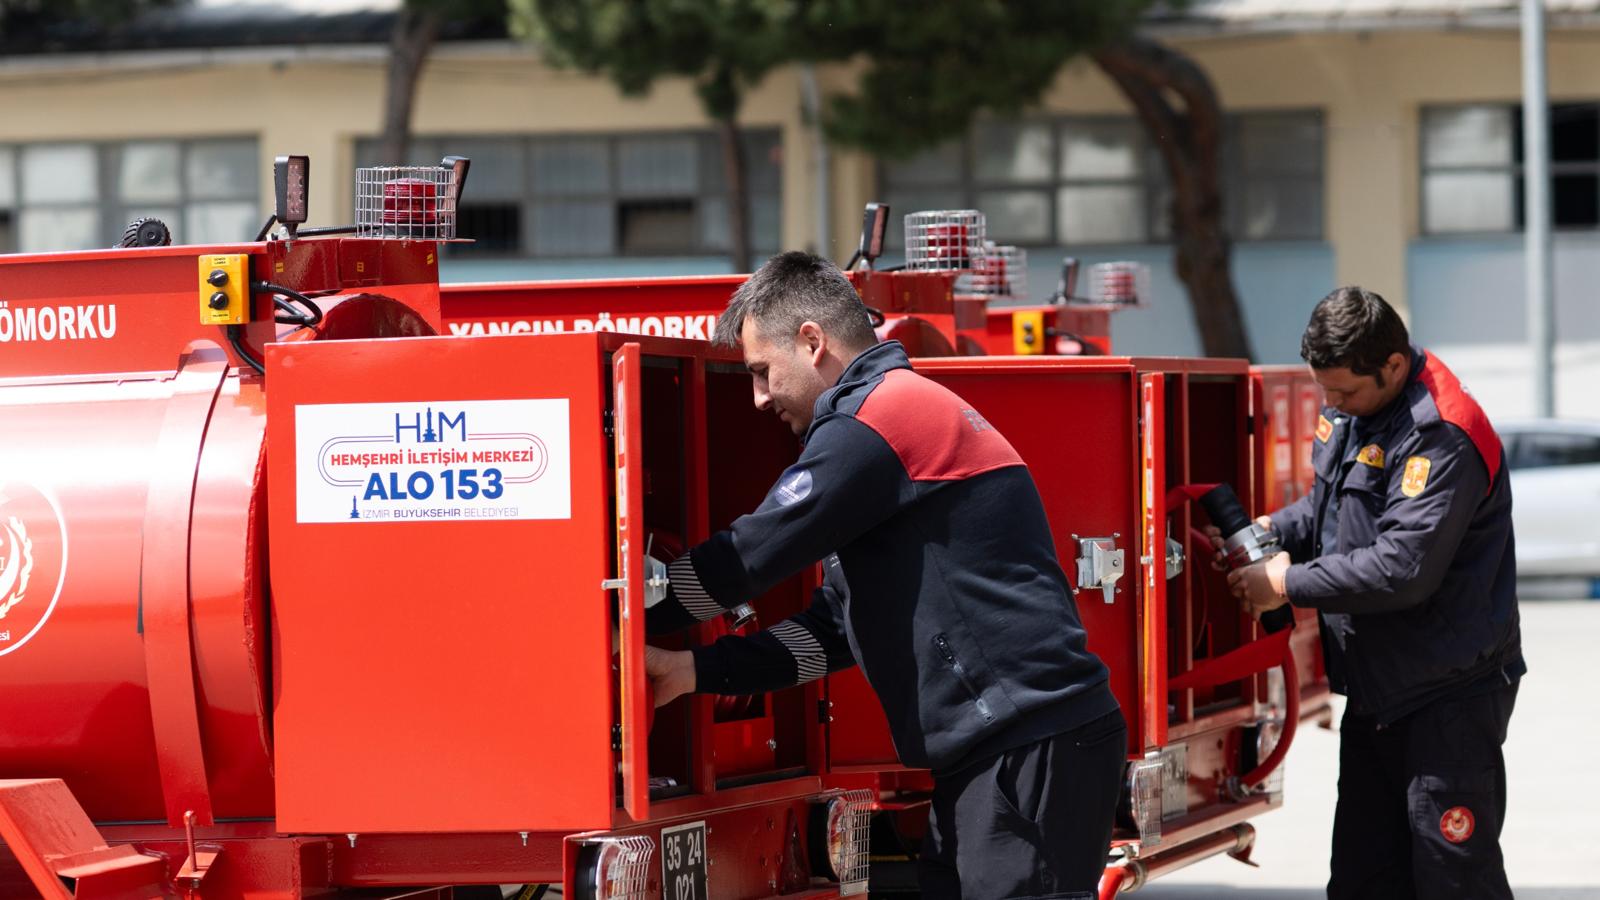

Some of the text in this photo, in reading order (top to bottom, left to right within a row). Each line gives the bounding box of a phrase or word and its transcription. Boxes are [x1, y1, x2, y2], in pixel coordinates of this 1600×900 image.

[331, 446, 534, 468] HEMŞEHRİ İLETİŞİM MERKEZİ
[363, 468, 504, 500] ALO 153
[666, 830, 702, 871] 35 24
[675, 872, 696, 900] 021
